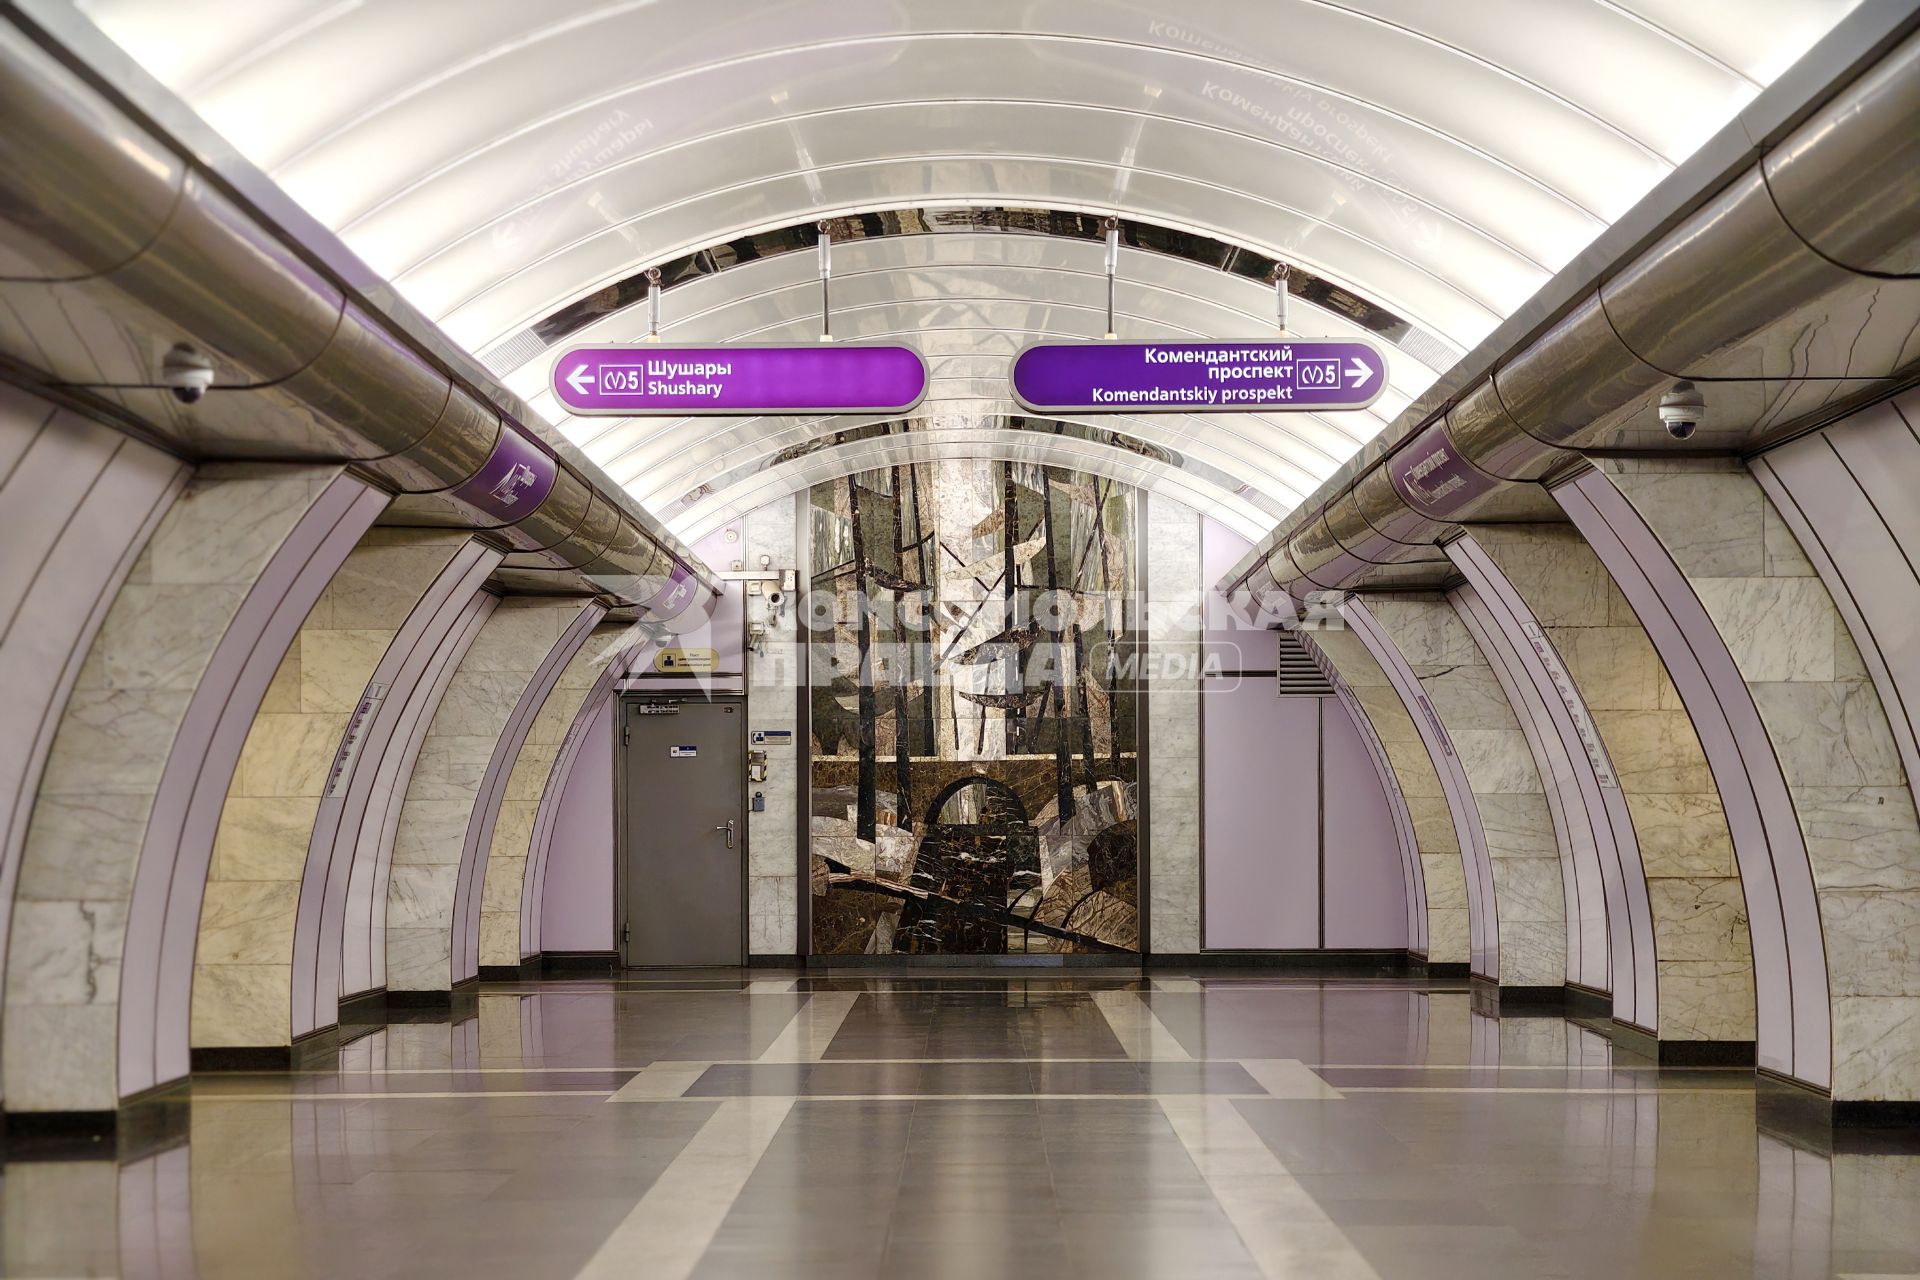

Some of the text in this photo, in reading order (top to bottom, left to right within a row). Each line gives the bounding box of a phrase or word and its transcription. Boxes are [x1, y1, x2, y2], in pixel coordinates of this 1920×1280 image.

[1145, 345, 1293, 364] Комендантский
[648, 360, 732, 379] Шушары
[1208, 365, 1294, 382] проспект
[648, 380, 723, 398] Shushary
[1092, 385, 1293, 404] Komendantskiy prospekt
